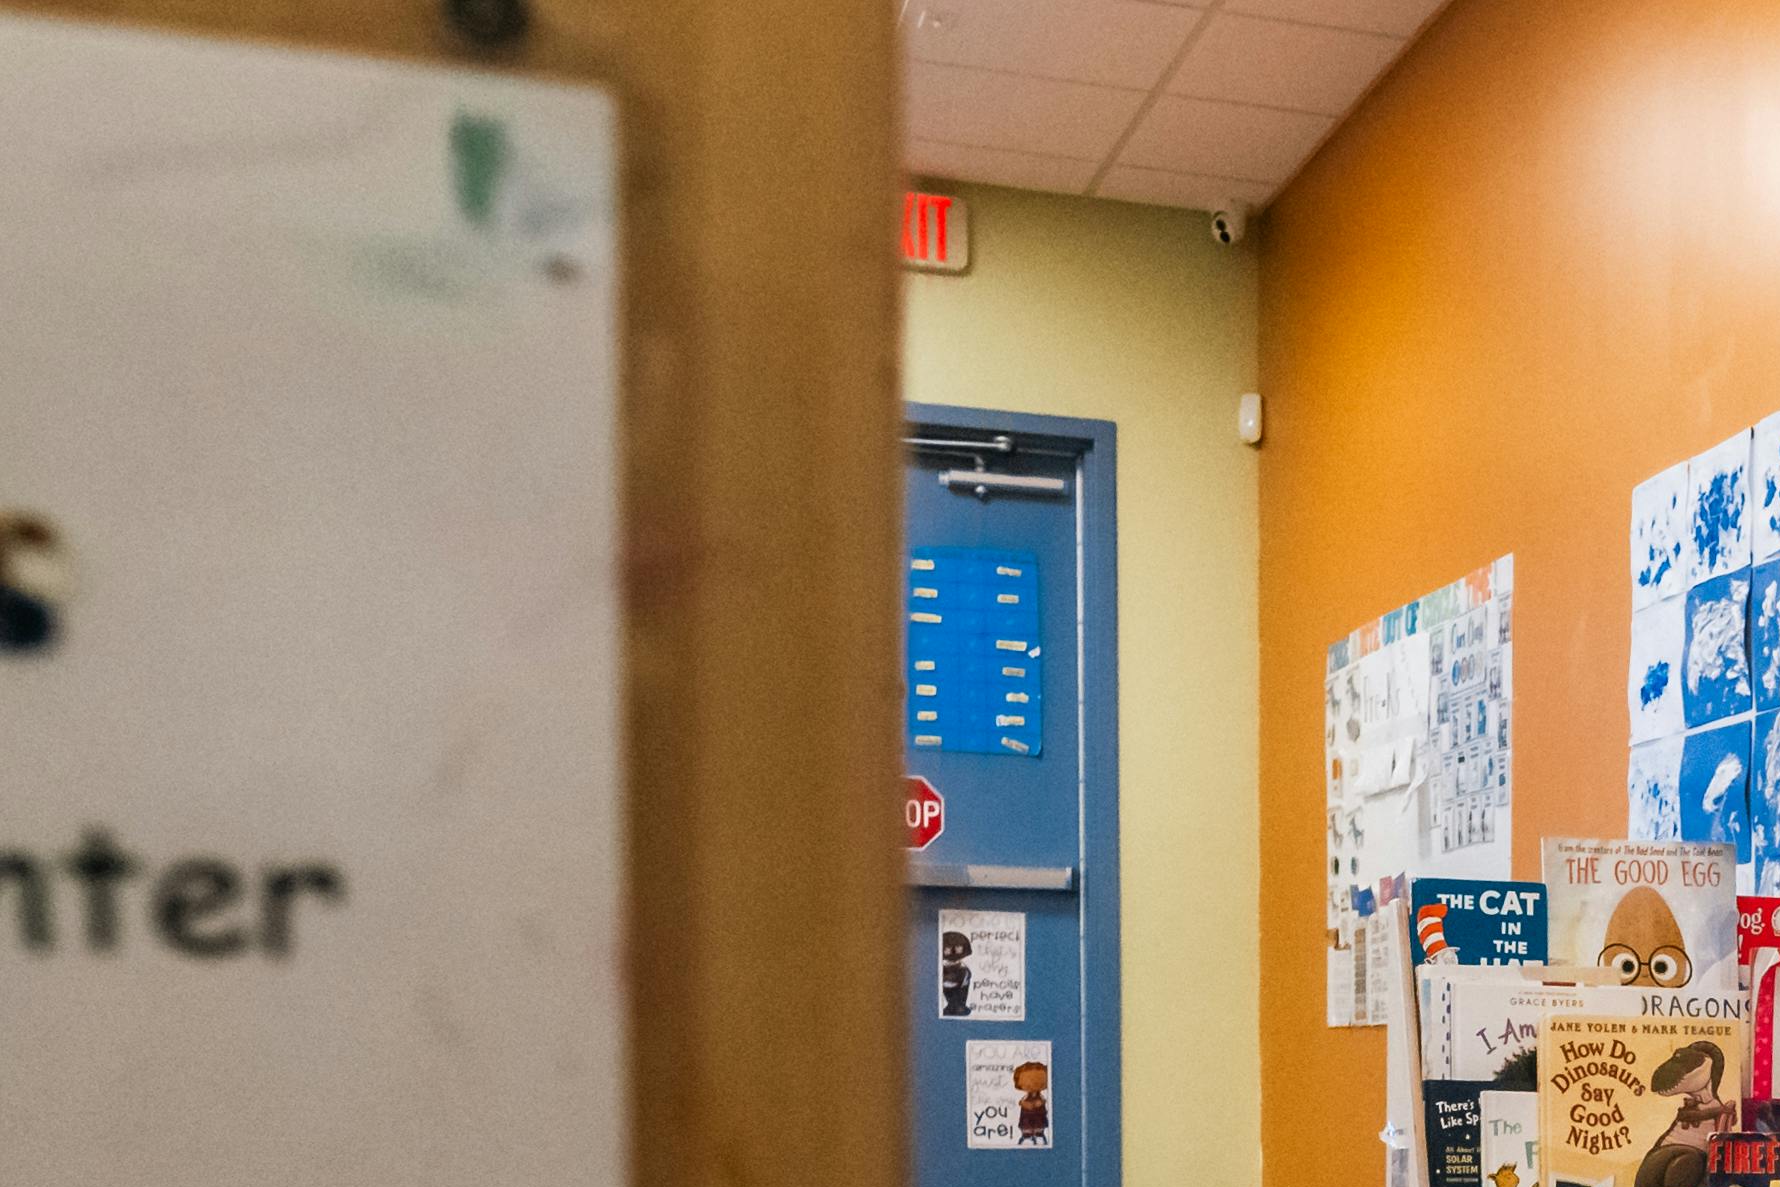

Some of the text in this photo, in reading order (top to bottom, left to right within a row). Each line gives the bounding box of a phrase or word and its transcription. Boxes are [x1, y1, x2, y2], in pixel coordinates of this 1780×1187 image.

[1566, 857, 1722, 888] THE GOOD EGG
[1436, 889, 1540, 916] THE CAT
[1501, 921, 1521, 935] IN
[1493, 939, 1528, 955] THE
[1509, 996, 1585, 1008] GRACE BYERS
[1498, 1017, 1538, 1045] Am
[1550, 1022, 1582, 1033] JANE
[1587, 1023, 1627, 1034] YOLEN
[1642, 1024, 1678, 1035] MARK
[1683, 1025, 1732, 1036] TEAGUE
[1560, 1039, 1637, 1065] How Do
[1550, 1061, 1647, 1097] Dinosaurs
[1580, 1082, 1615, 1107] Say
[974, 1106, 1008, 1125] you
[1435, 1098, 1475, 1114] There's
[1569, 1103, 1625, 1127] Good
[973, 1123, 1014, 1140] are!
[1439, 1116, 1463, 1130] Like
[1488, 1118, 1523, 1137] The
[1565, 1126, 1632, 1155] Night?
[1445, 1154, 1473, 1164] SOLAR
[1445, 1164, 1479, 1175] SYSTEM
